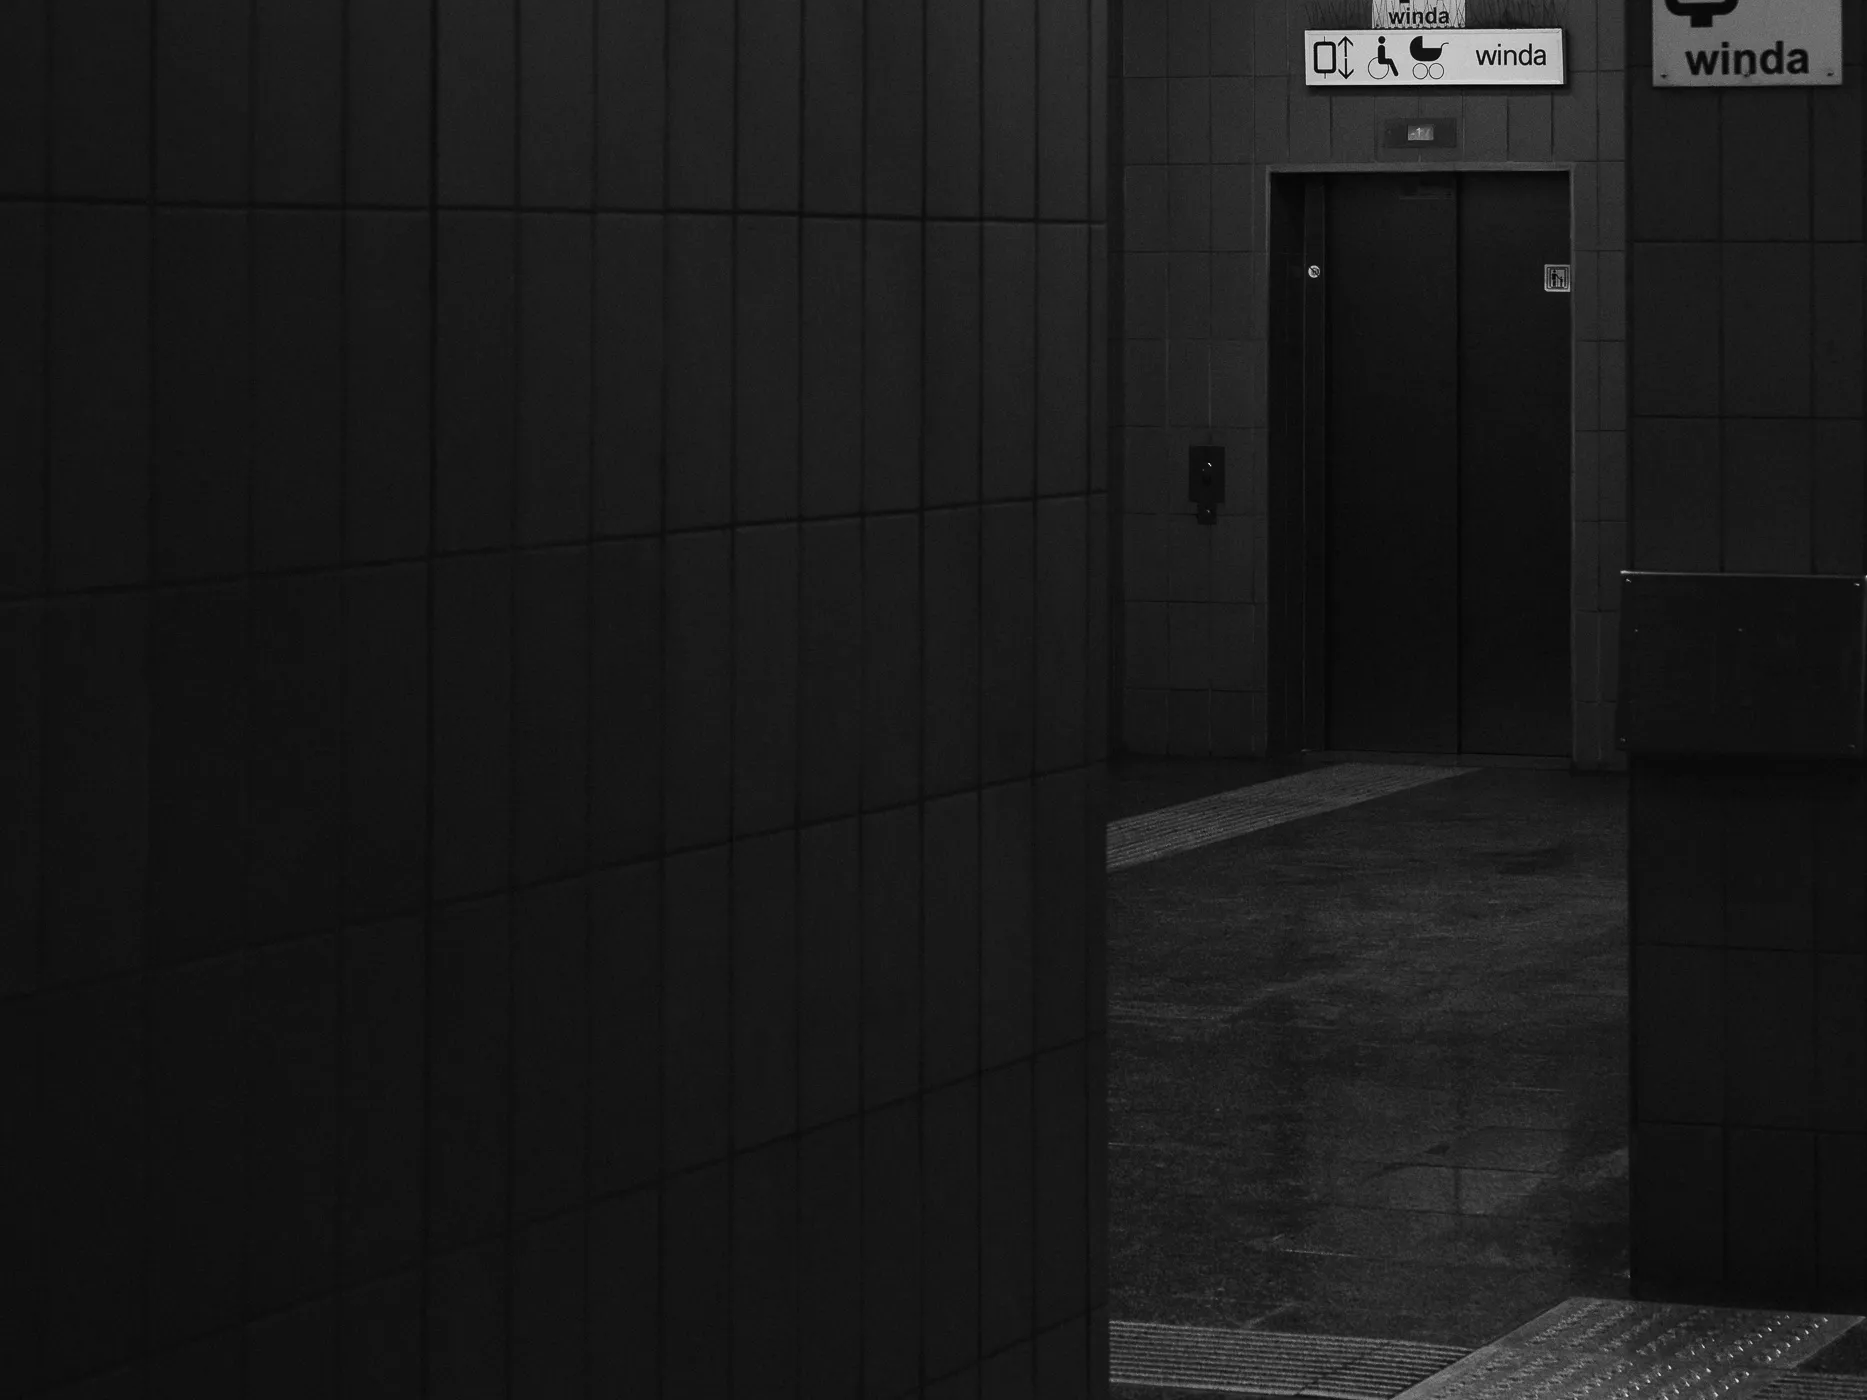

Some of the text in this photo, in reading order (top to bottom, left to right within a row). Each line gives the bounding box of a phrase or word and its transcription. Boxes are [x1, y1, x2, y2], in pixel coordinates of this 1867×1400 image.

[1388, 7, 1450, 25] winda
[1475, 43, 1547, 66] winda
[1685, 40, 1809, 75] winda
